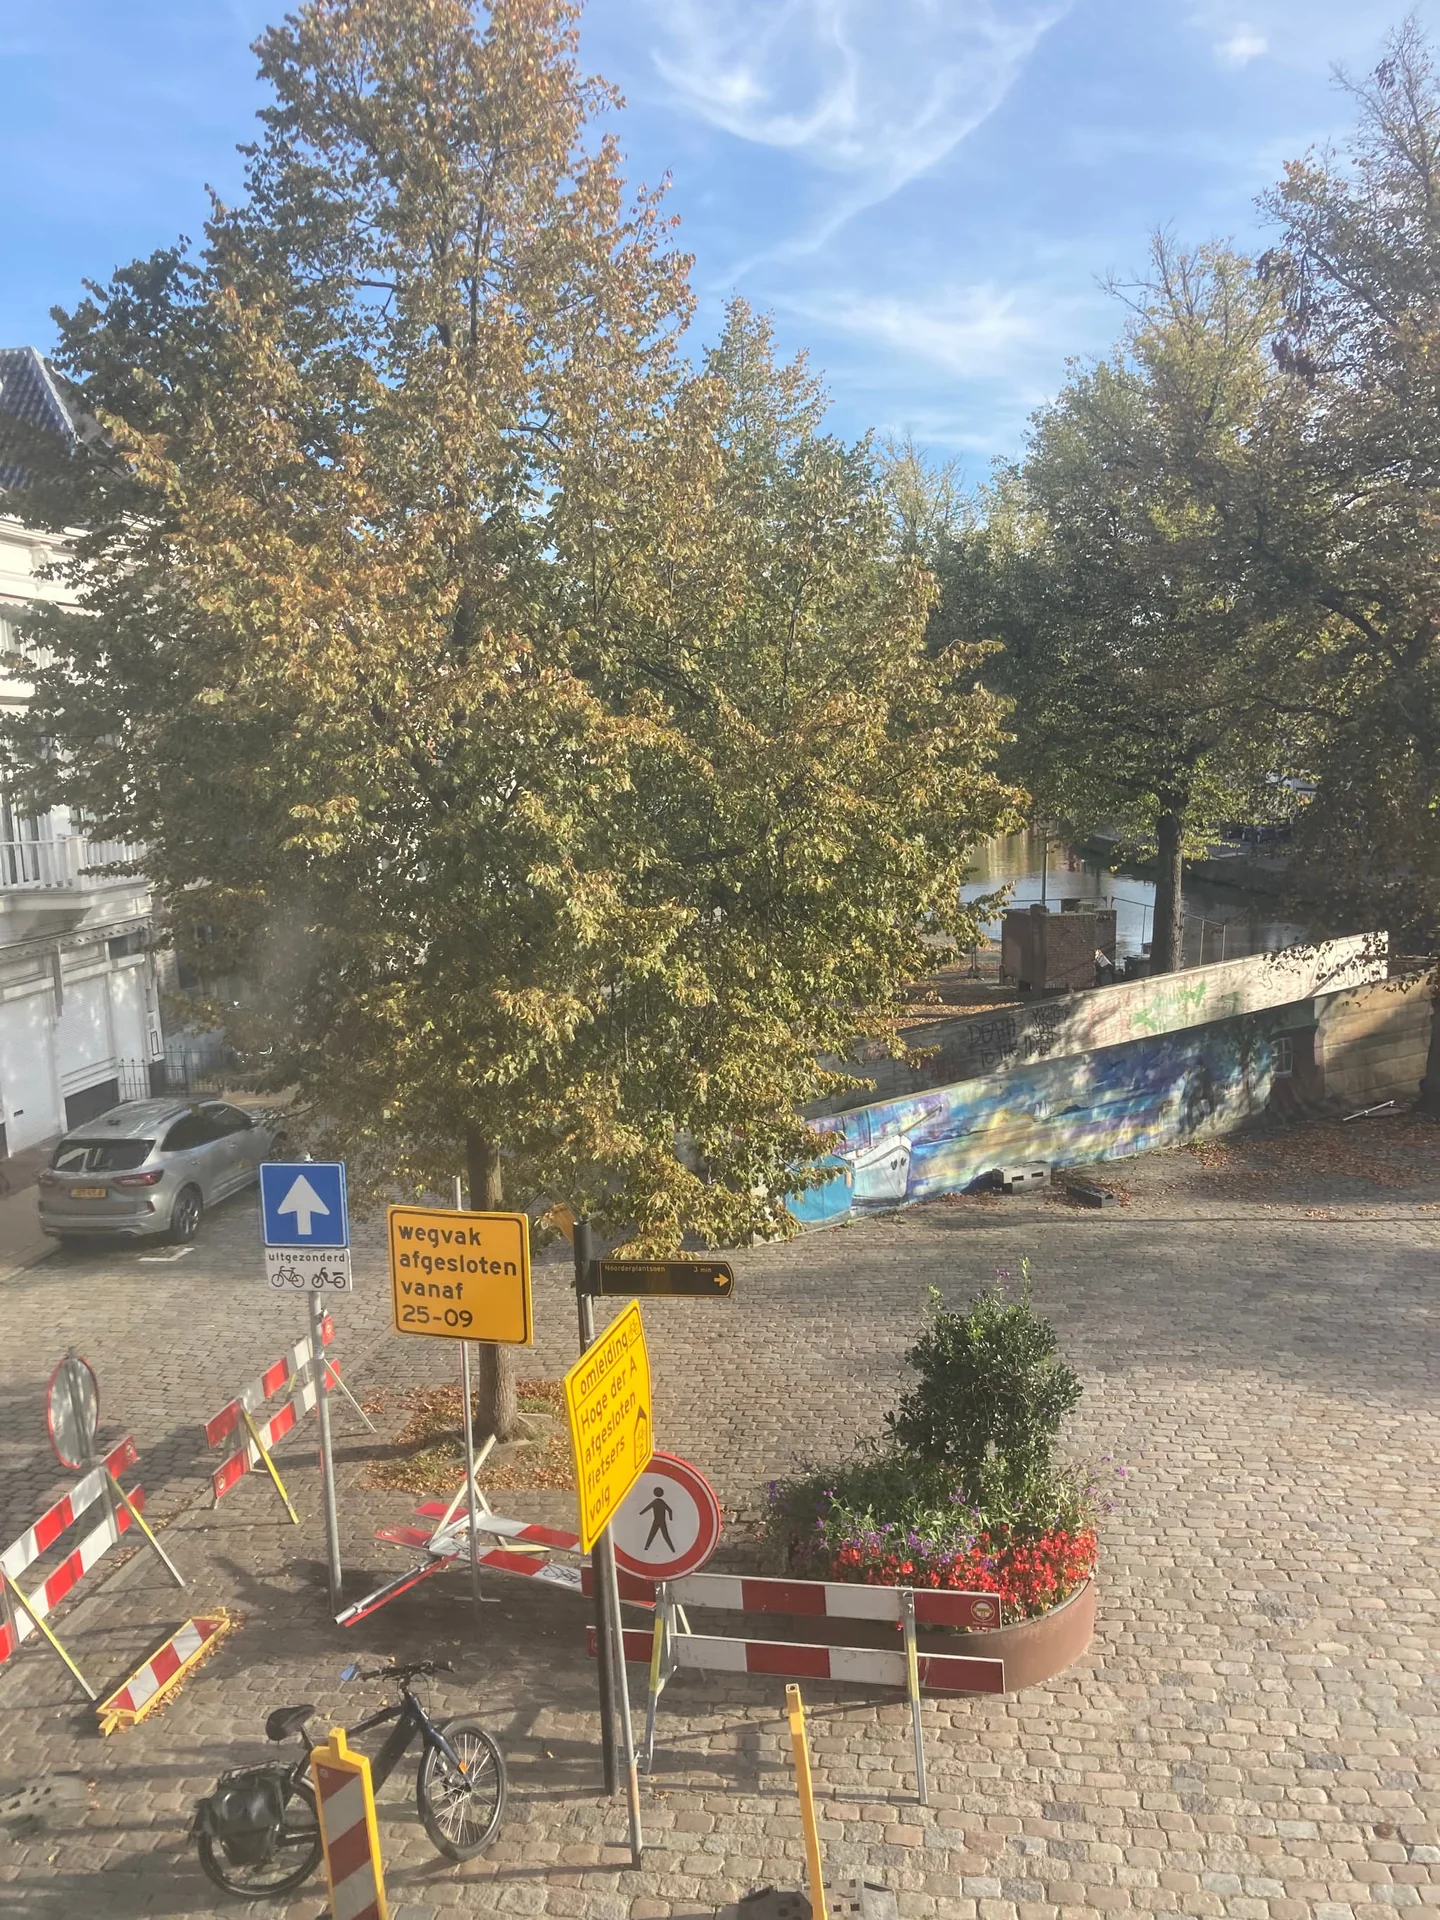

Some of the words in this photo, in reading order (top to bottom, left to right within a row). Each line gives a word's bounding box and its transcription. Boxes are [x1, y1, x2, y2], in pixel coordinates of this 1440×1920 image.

[398, 1225, 481, 1247] wegvak
[268, 1252, 345, 1263] uitgezonderd
[399, 1251, 517, 1276] afgesloten
[604, 1265, 666, 1273] Noorderplantsoen
[401, 1280, 463, 1300] vanaf
[402, 1304, 473, 1327] 25-09
[580, 1332, 629, 1396] omleiding
[581, 1393, 608, 1435] Hoge
[610, 1370, 626, 1399] der
[630, 1356, 637, 1377] A
[585, 1392, 636, 1465] afgesloten
[588, 1435, 625, 1495] fietsers
[589, 1485, 610, 1522] volg
